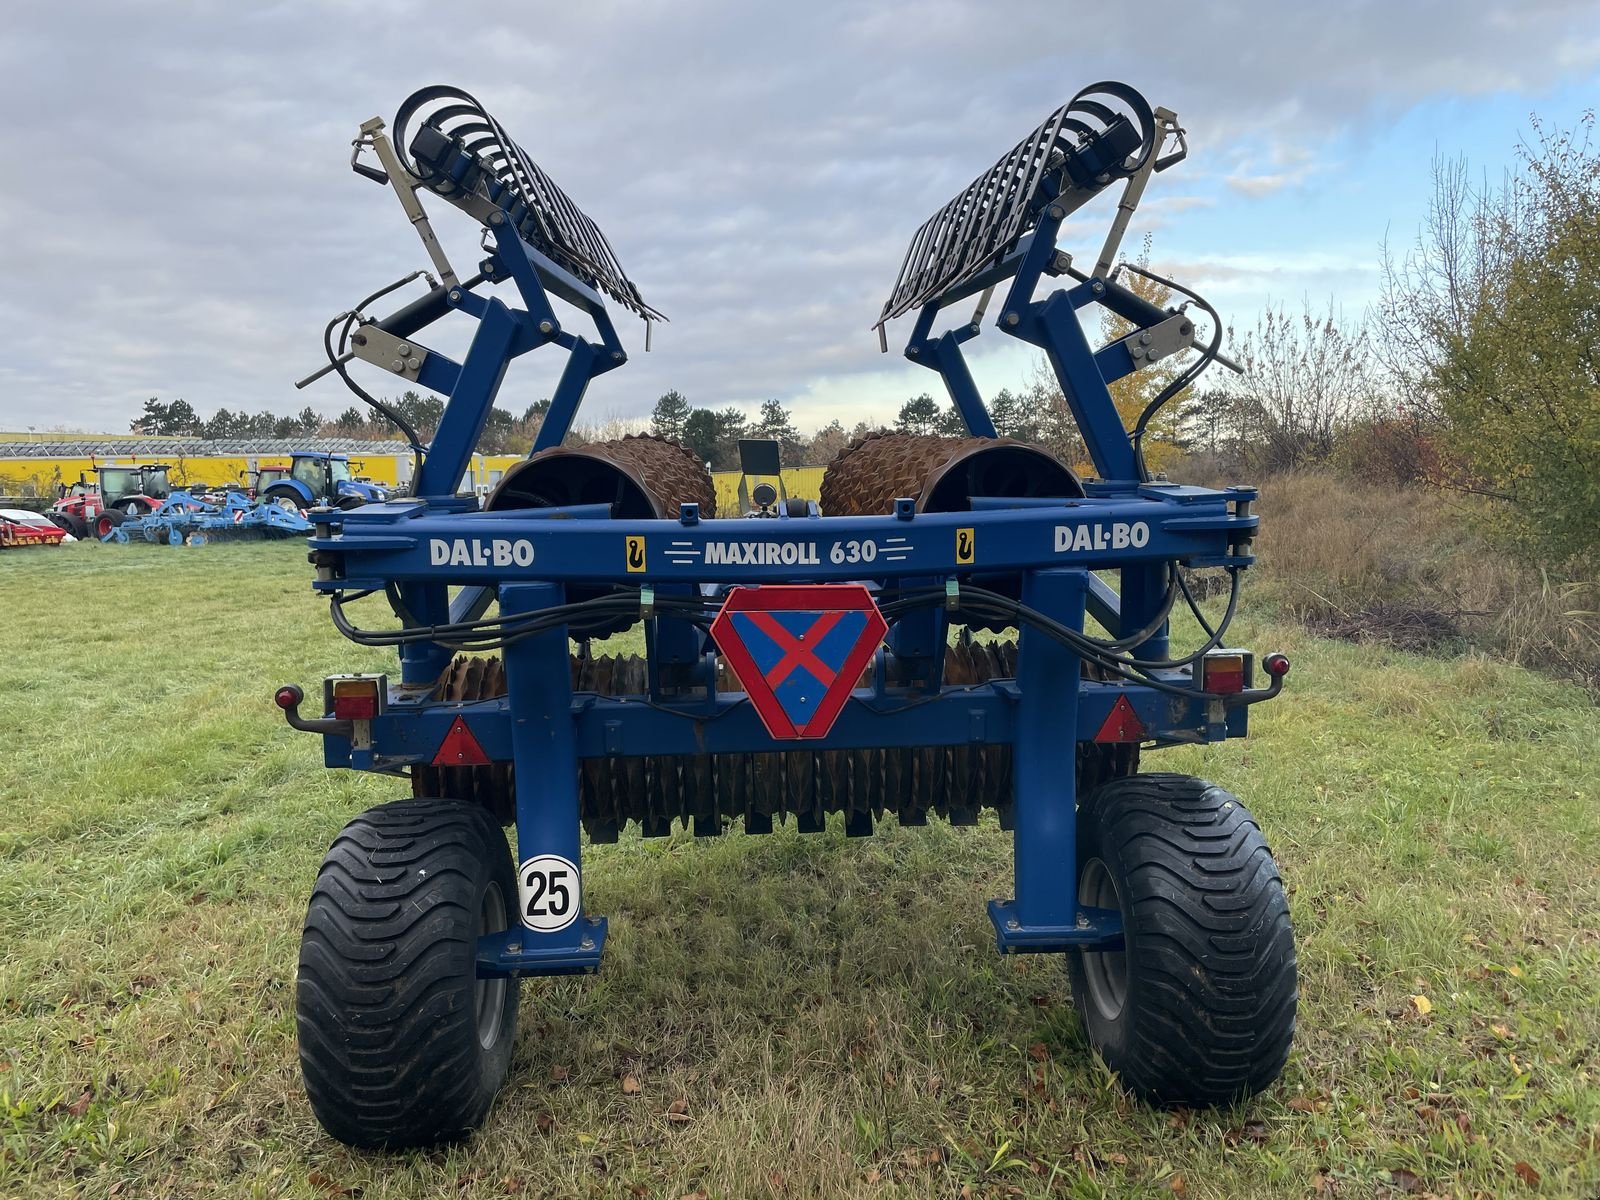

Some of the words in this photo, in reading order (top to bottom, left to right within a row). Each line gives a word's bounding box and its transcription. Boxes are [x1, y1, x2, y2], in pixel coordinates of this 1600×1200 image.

[704, 542, 820, 565] MAXIROLL
[829, 540, 877, 564] 630
[526, 871, 570, 916] 25
